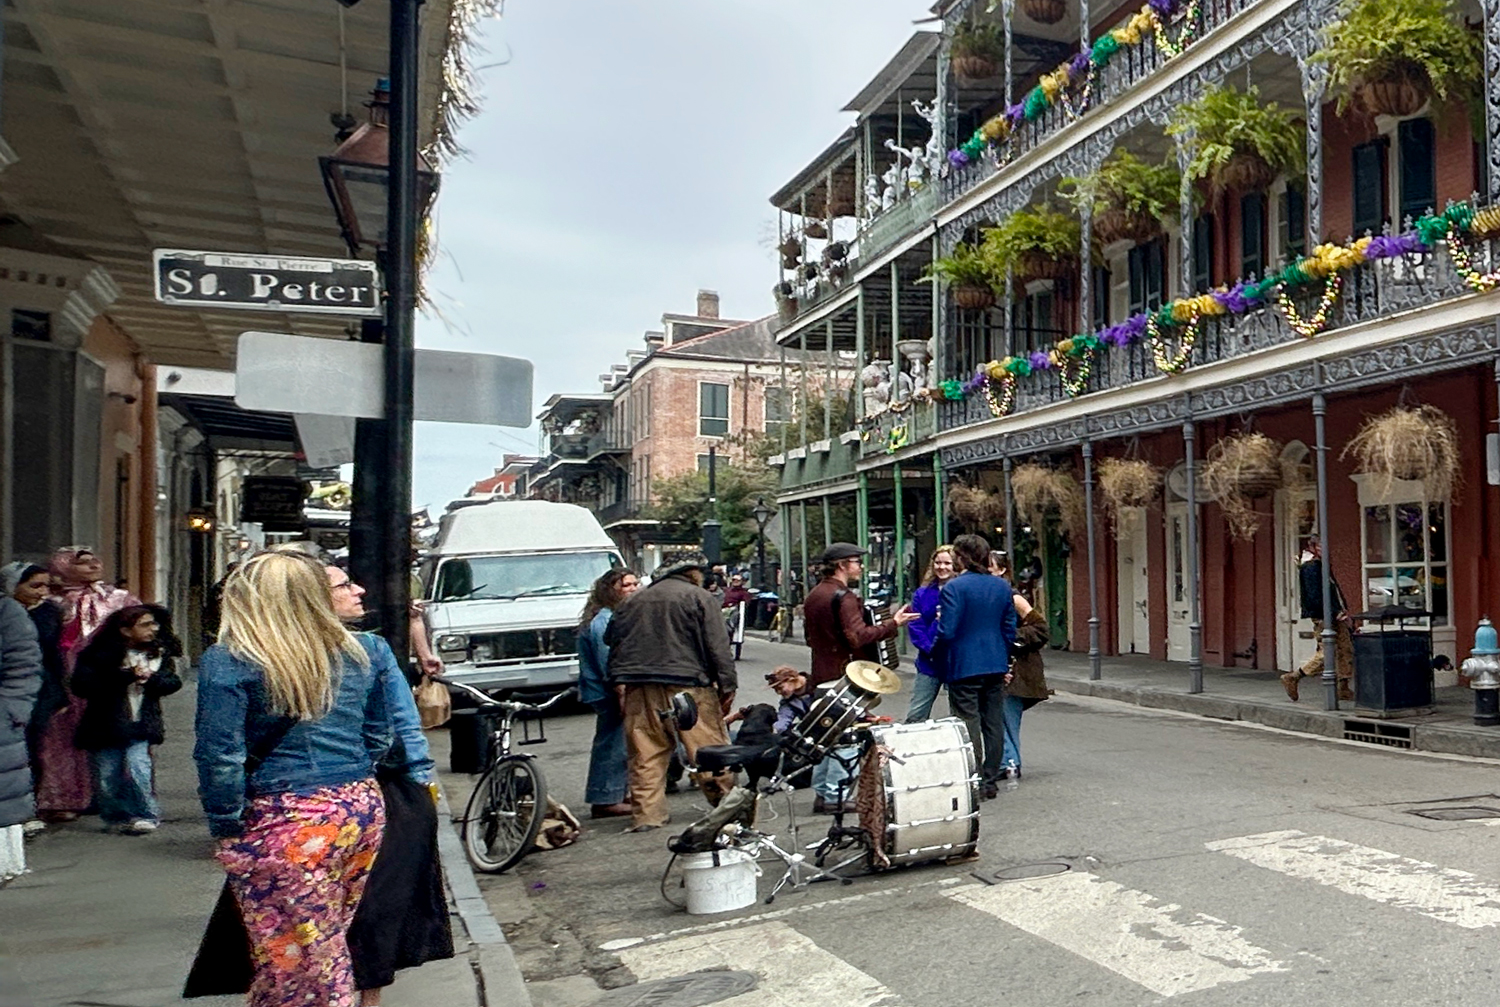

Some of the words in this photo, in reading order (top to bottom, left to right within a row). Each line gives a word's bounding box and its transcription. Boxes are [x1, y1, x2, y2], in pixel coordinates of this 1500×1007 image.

[221, 256, 248, 267] Rue
[277, 259, 320, 271] Pierre
[167, 269, 227, 295] St.
[251, 273, 368, 303] Peter
